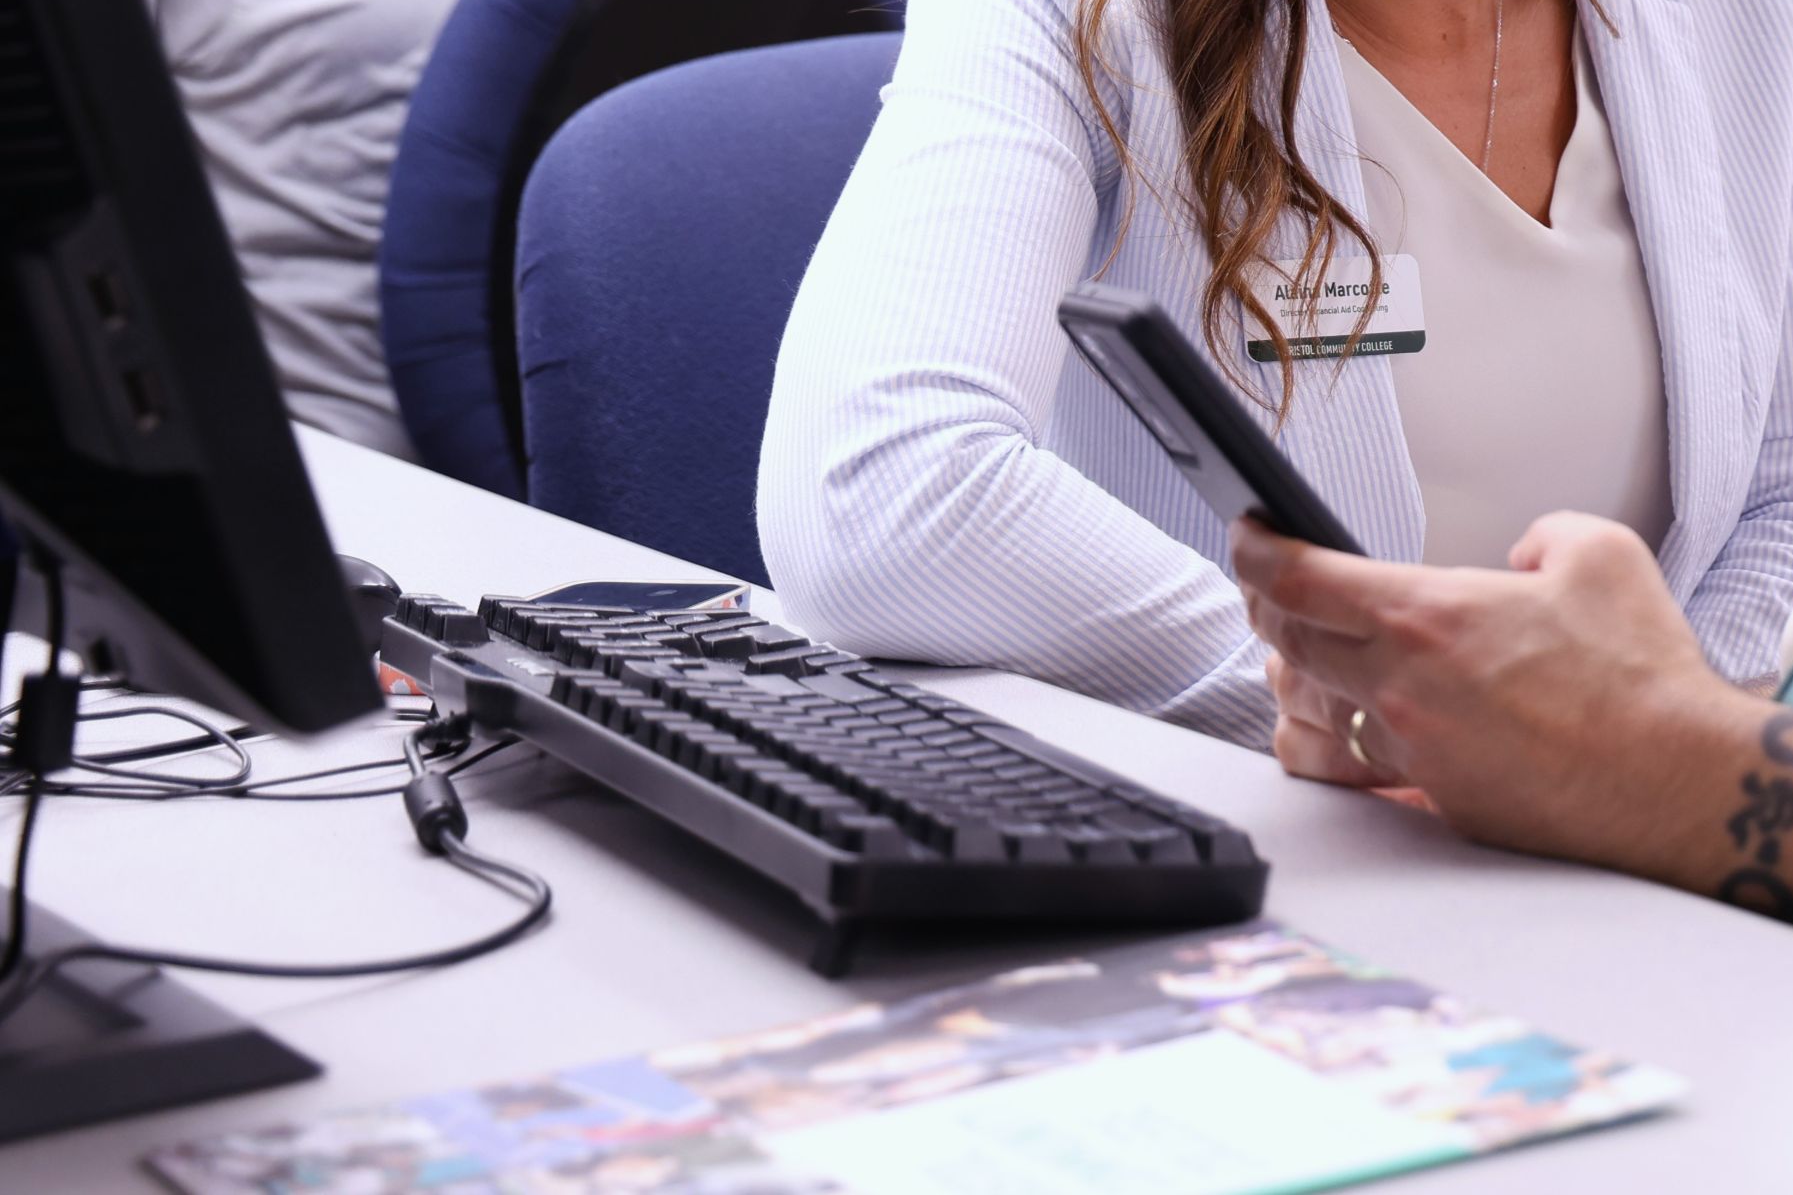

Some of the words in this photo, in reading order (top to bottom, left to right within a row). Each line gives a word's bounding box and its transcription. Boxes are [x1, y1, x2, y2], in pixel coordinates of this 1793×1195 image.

[1324, 282, 1390, 298] Marcoe
[1340, 305, 1351, 314] Aid
[1286, 344, 1315, 356] RISTOL
[1361, 340, 1394, 352] COLLEGE
